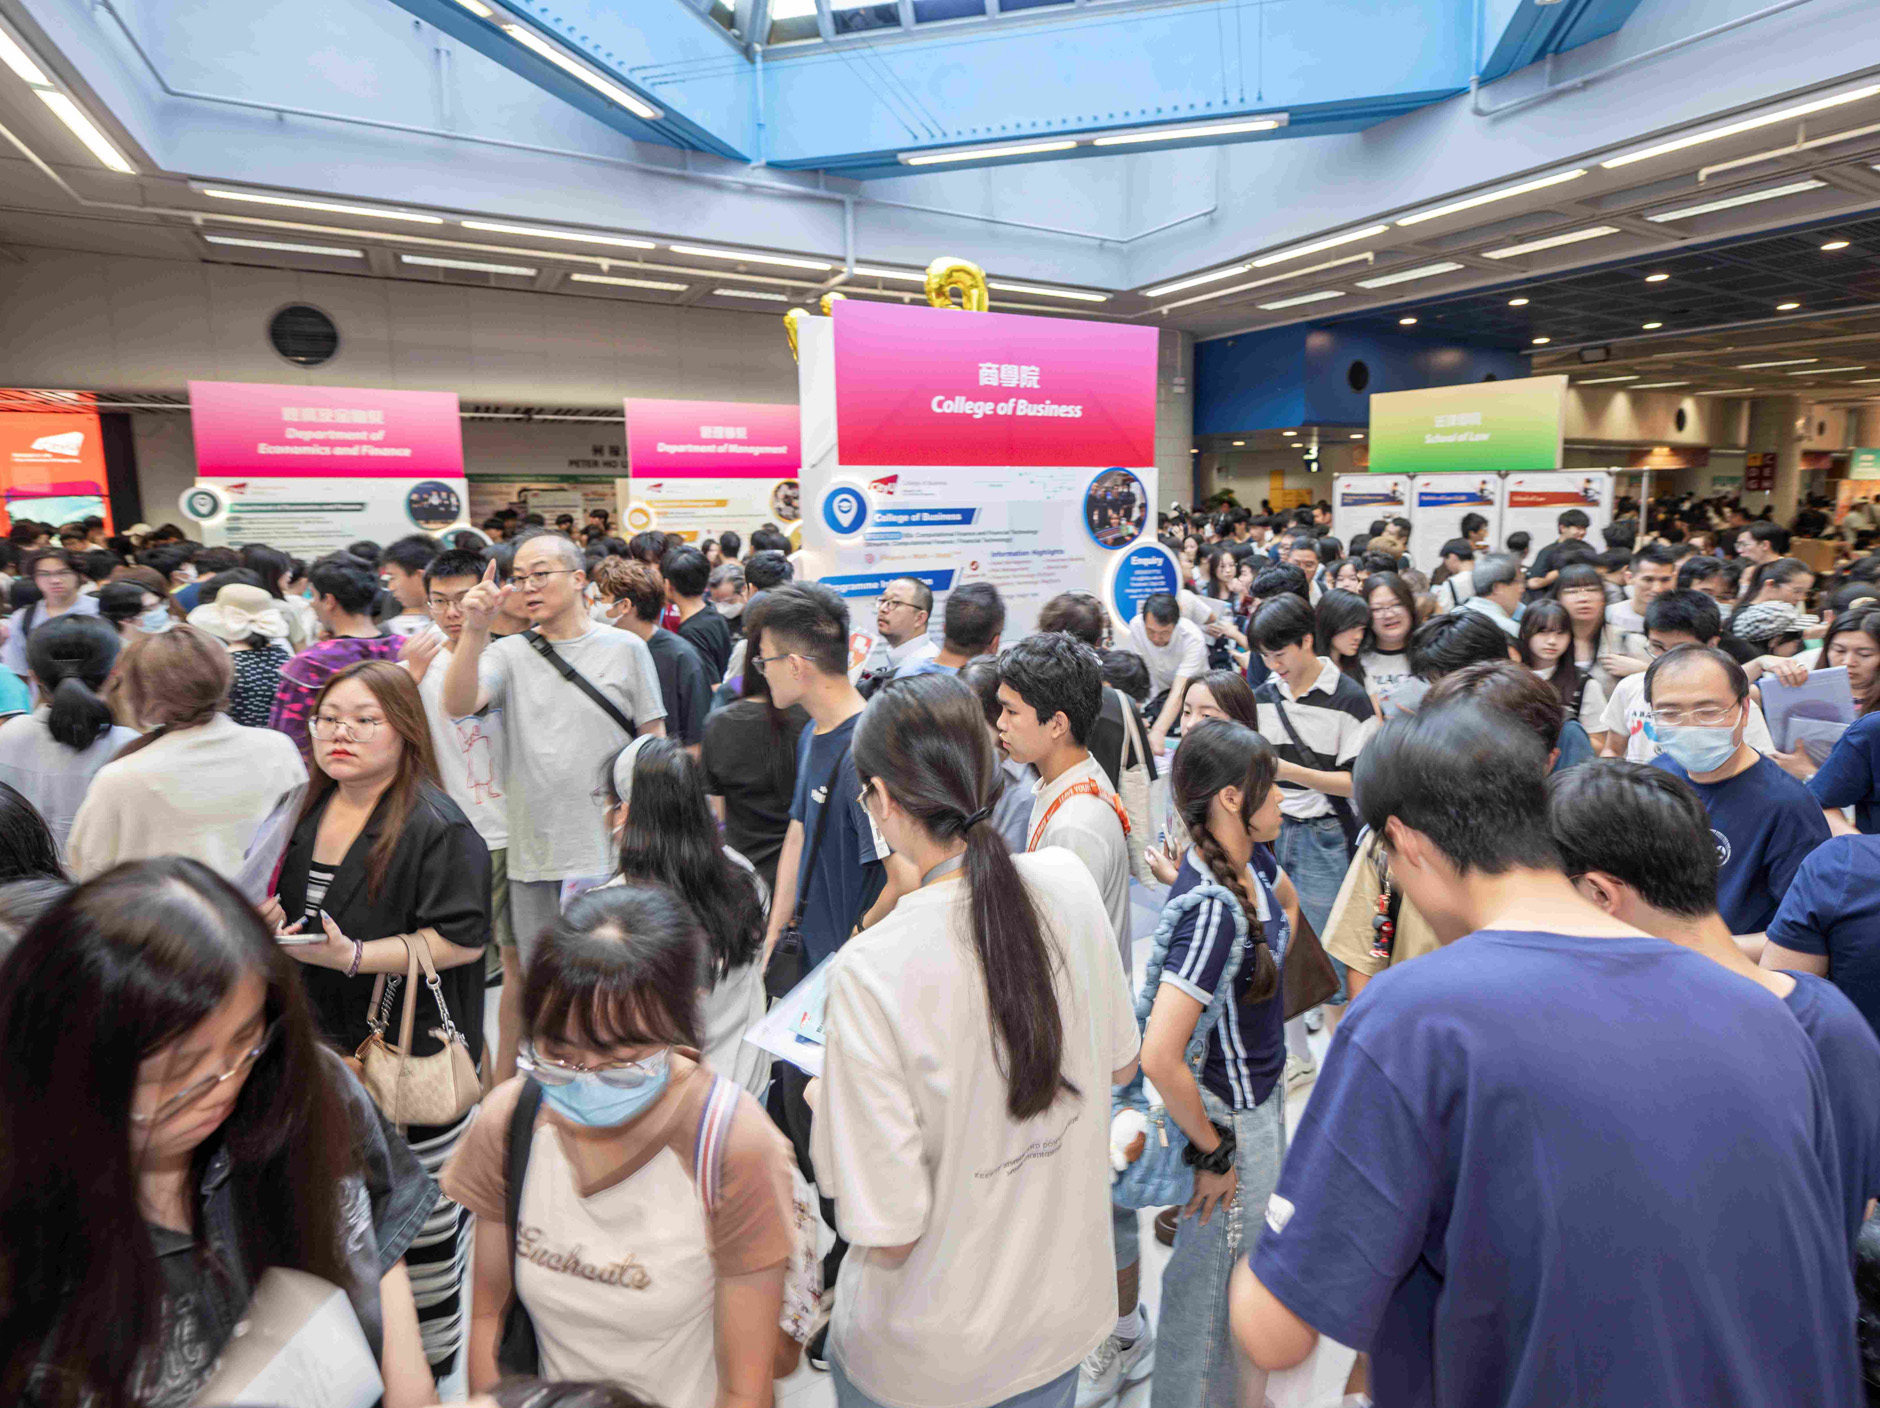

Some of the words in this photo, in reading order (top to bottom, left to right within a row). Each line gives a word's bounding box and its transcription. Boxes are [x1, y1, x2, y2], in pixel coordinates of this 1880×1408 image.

[978, 362, 1041, 389] 商學院
[931, 395, 995, 419] College
[996, 397, 1016, 416] of
[1016, 399, 1083, 418] Business
[285, 427, 369, 442] Department
[369, 430, 386, 441] of
[1424, 432, 1456, 444] School
[1457, 432, 1469, 443] of
[1469, 431, 1491, 442] Law
[257, 442, 331, 455] Economics
[332, 445, 360, 456] and
[360, 445, 412, 457] Finance
[656, 442, 716, 454] Department
[716, 443, 729, 453] of
[729, 444, 788, 456] Management
[568, 459, 600, 468] PETER
[602, 459, 618, 468] HO
[873, 513, 909, 523] College
[910, 512, 921, 521] of
[921, 512, 963, 521] Business
[1130, 556, 1164, 567] Enquiry
